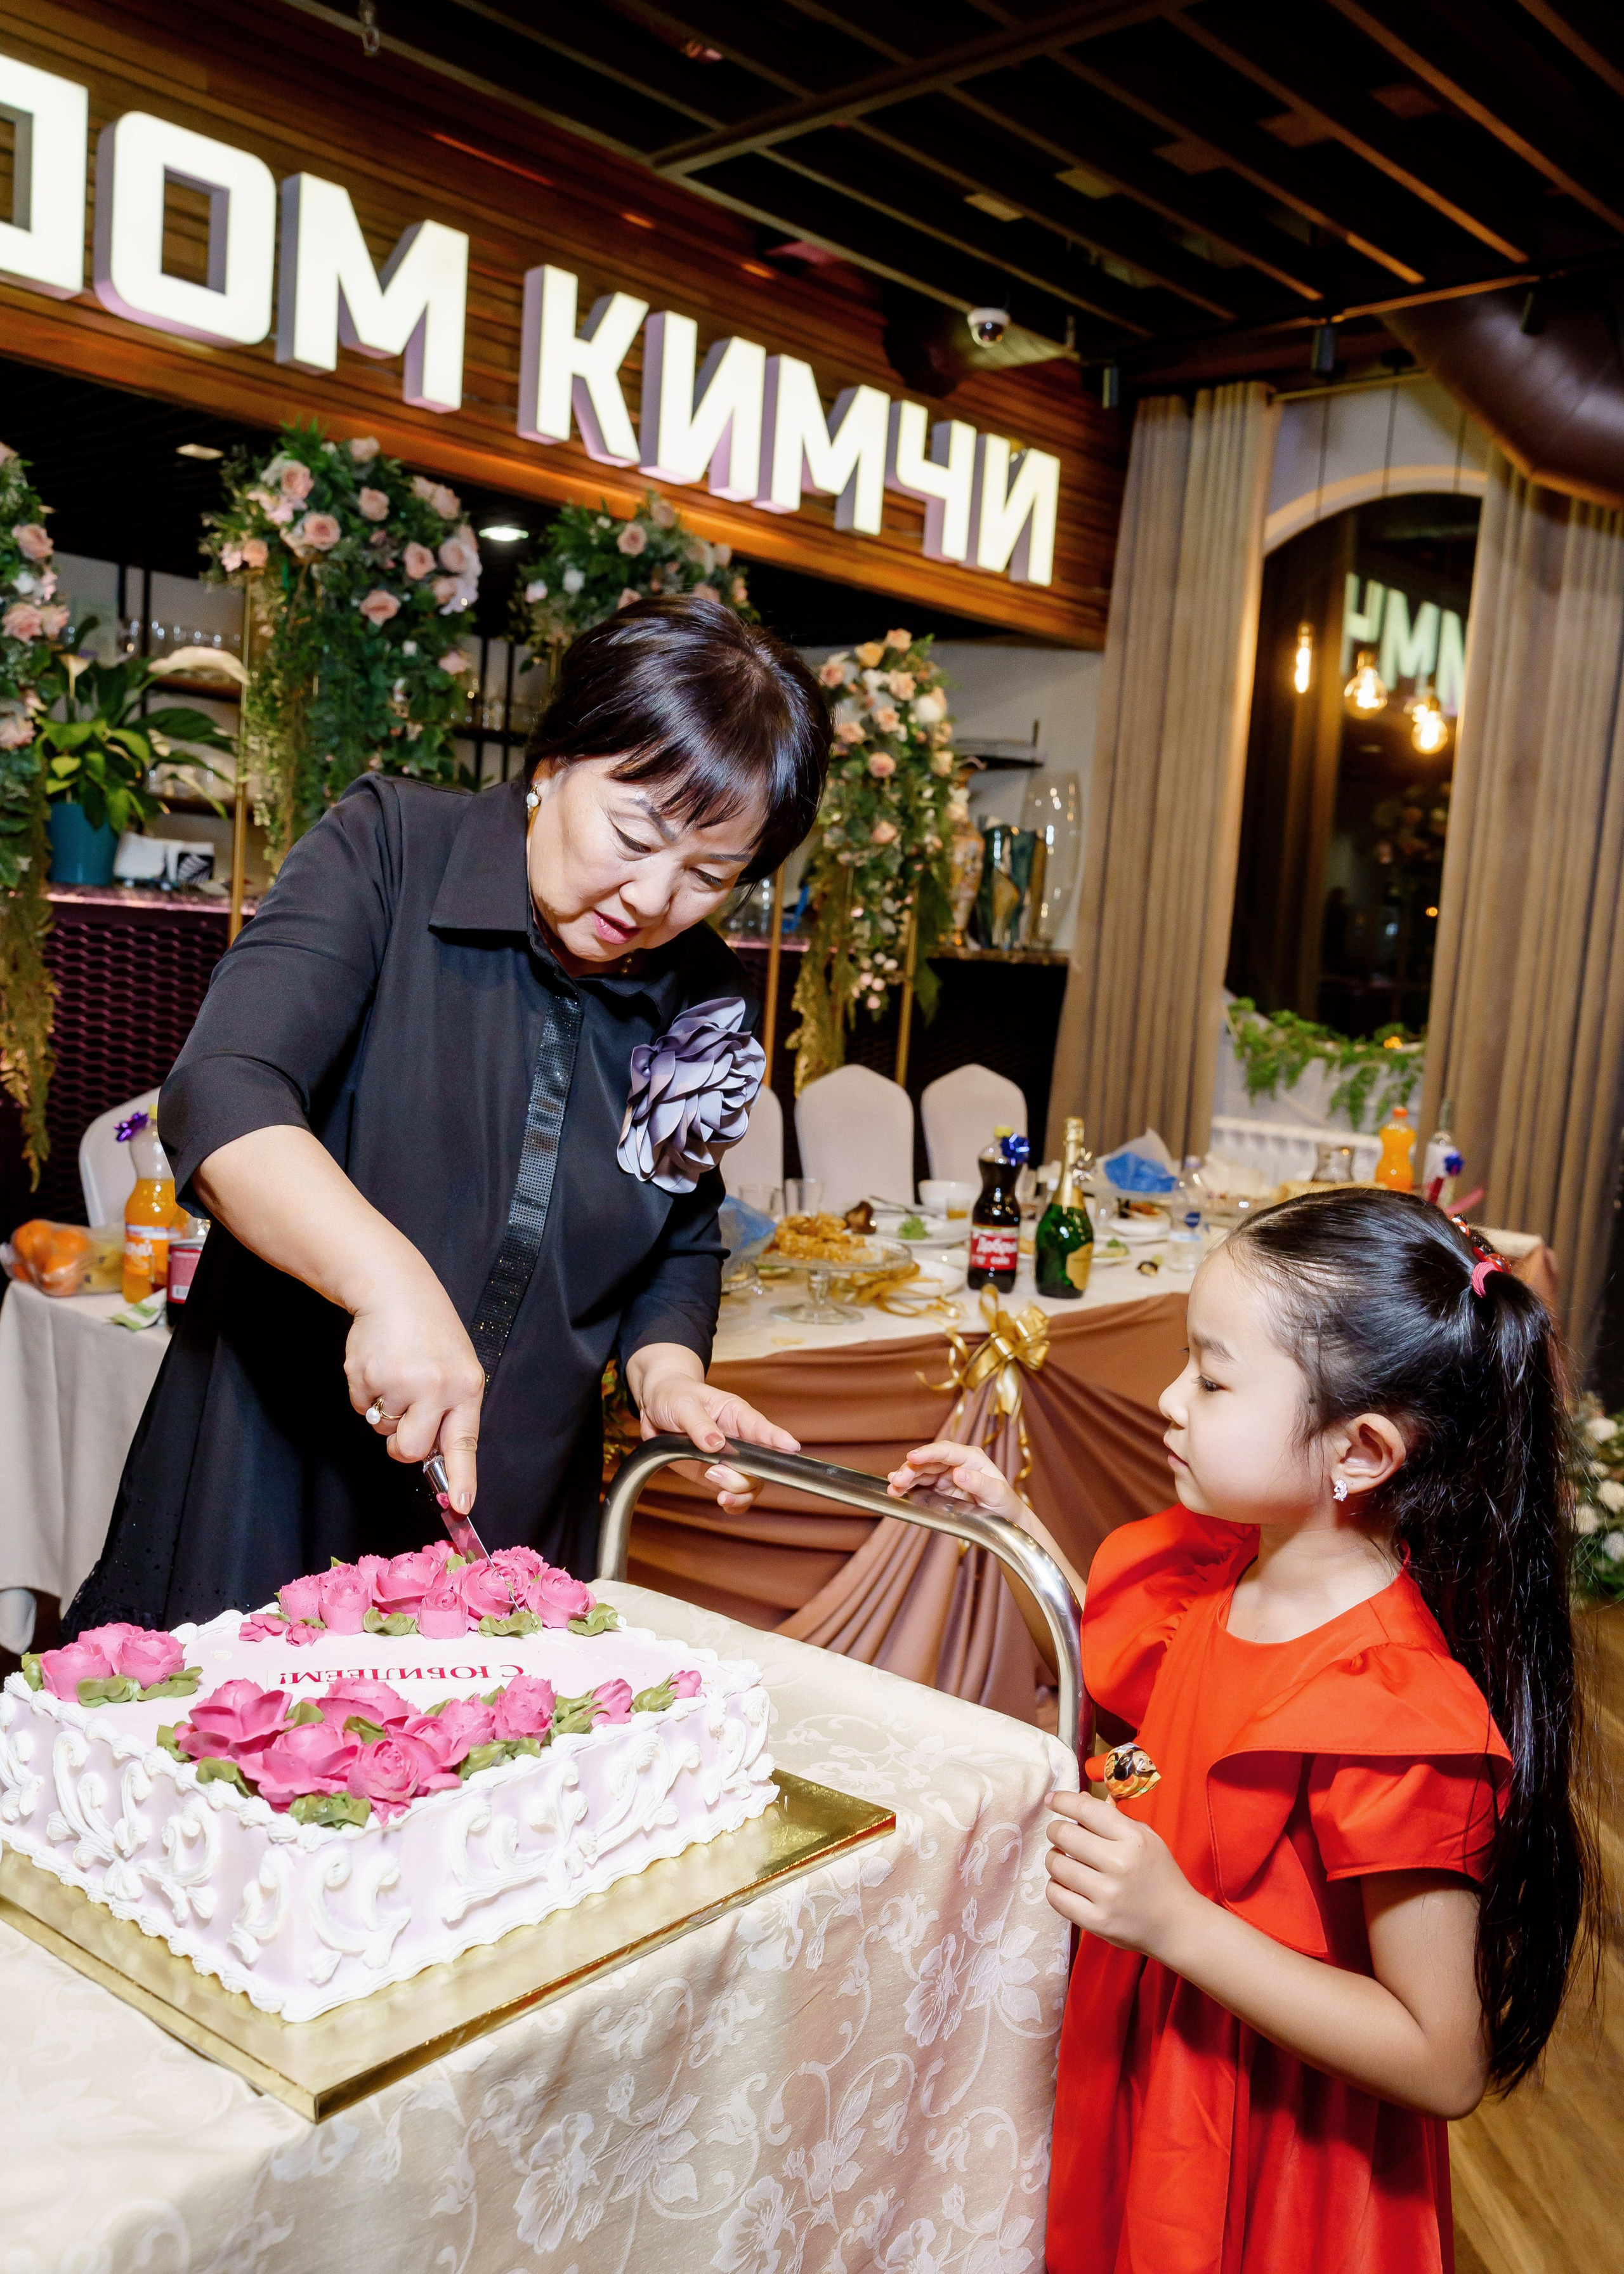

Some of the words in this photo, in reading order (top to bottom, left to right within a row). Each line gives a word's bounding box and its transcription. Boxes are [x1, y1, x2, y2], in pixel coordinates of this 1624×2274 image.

[517, 264, 1061, 587] КИМЧИ
[279, 1665, 492, 1685] ЮБИЛЕЕМ!
[499, 1664, 524, 1678] С
